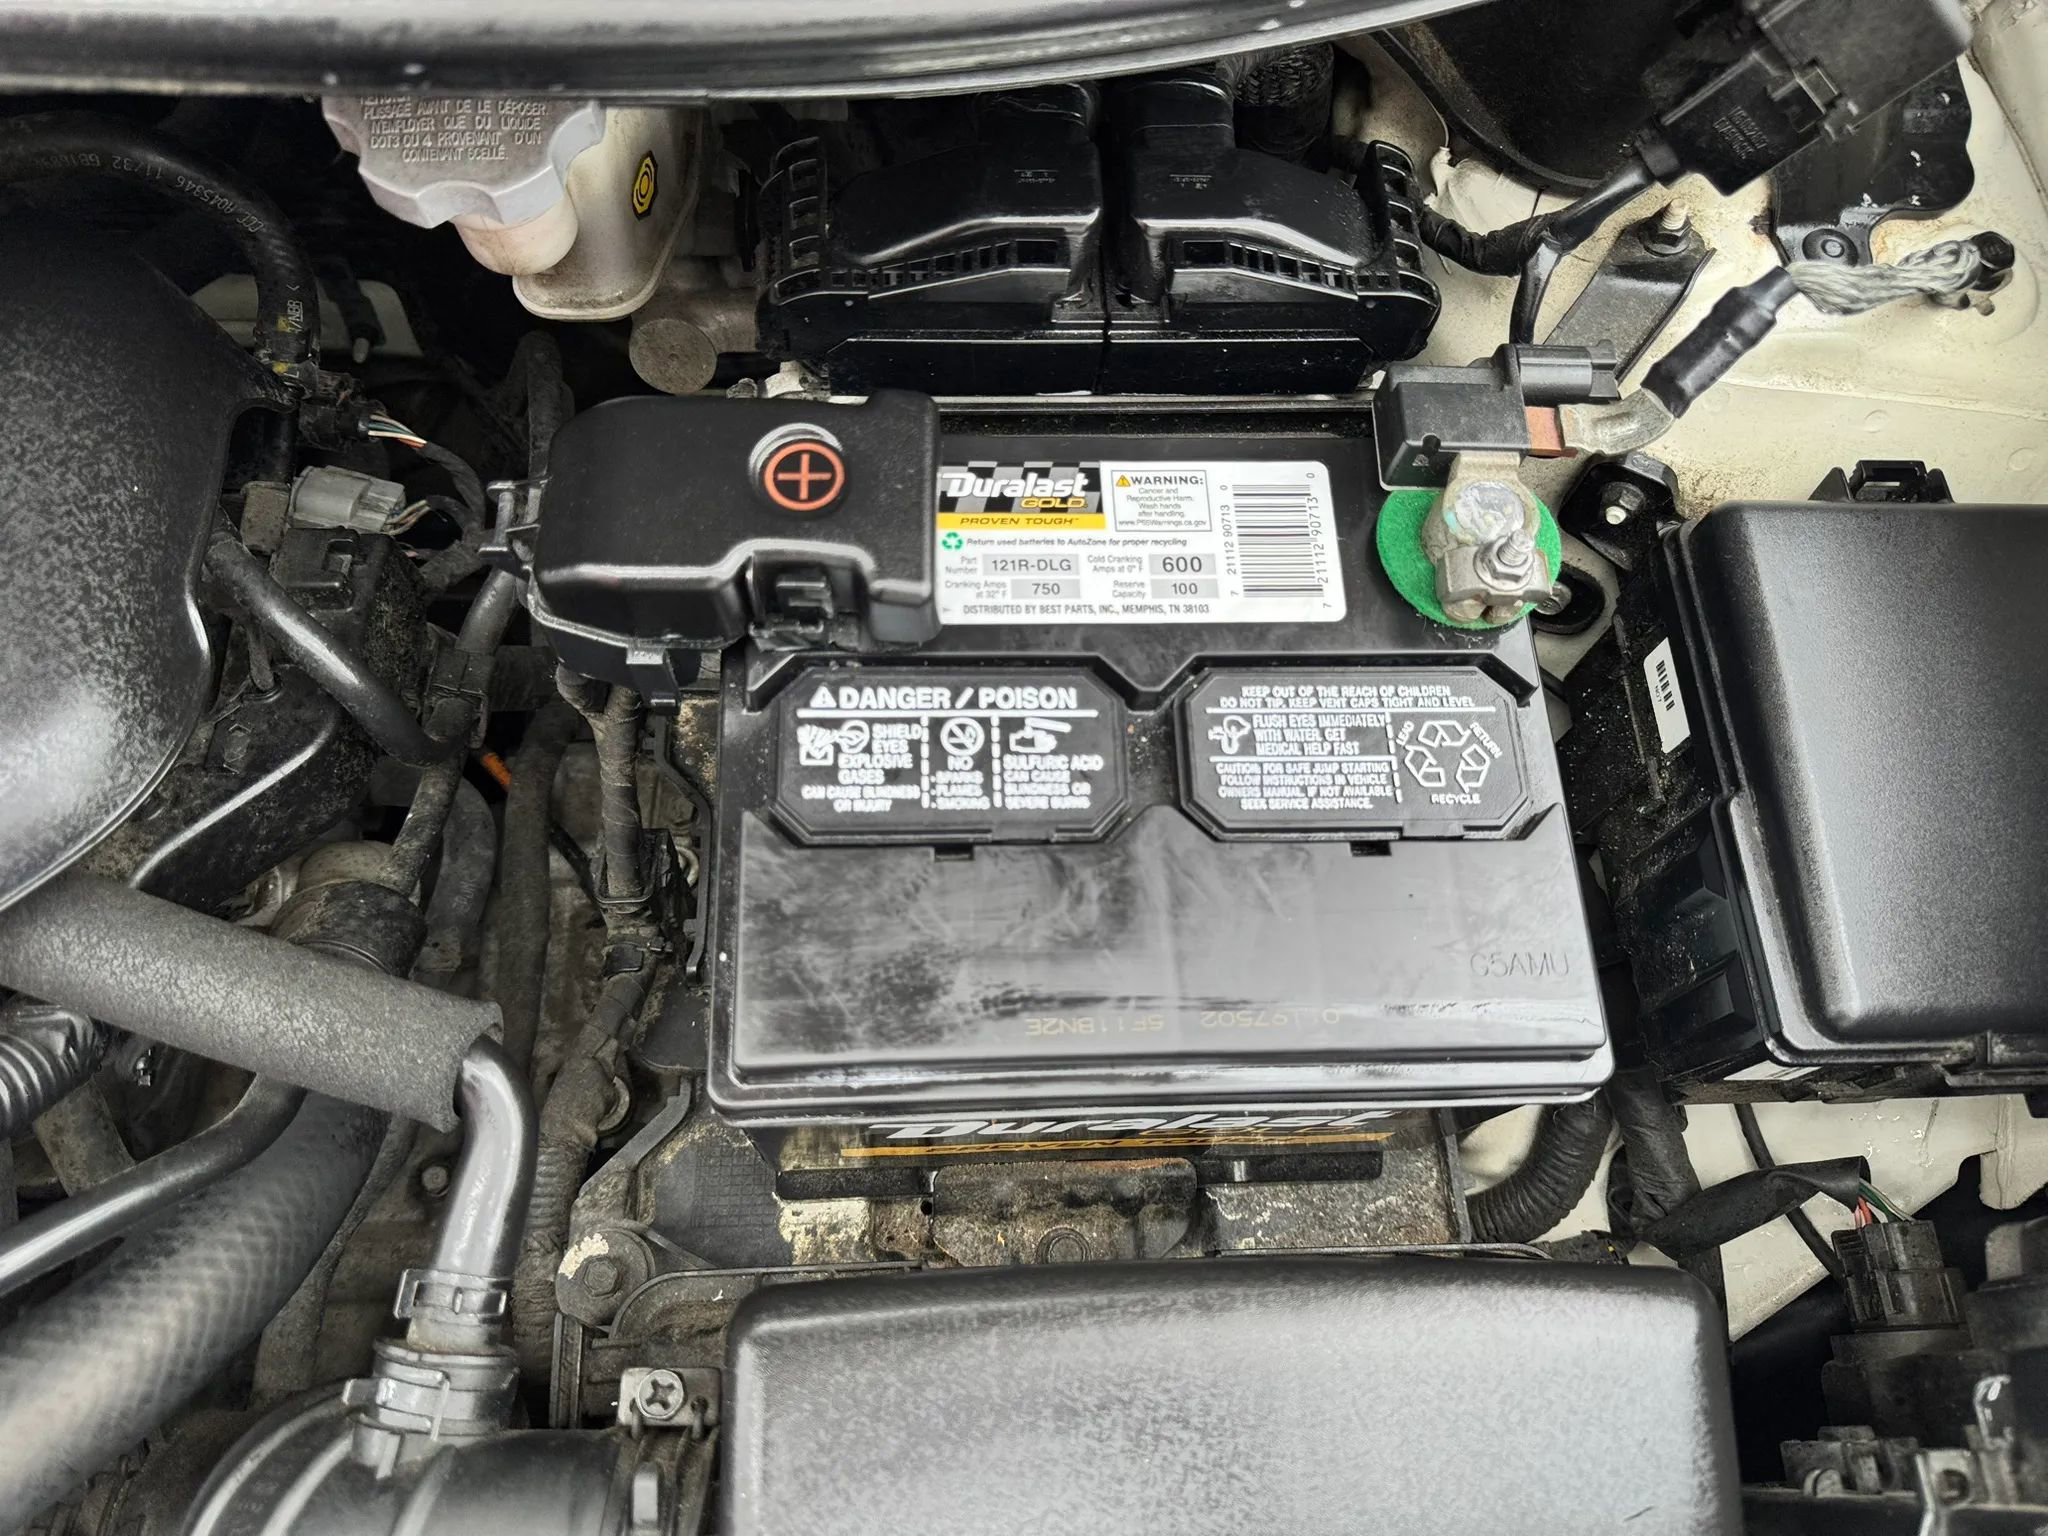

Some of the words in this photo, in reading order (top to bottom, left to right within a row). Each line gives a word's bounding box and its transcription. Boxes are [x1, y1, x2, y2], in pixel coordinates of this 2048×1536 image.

[363, 103, 412, 120] PLISSAGE
[417, 100, 450, 116] AVANT
[456, 99, 472, 115] DE
[478, 99, 492, 115] LE
[444, 115, 467, 131] QUE
[475, 116, 491, 131] DU
[501, 116, 541, 131] LIQUIDE
[403, 134, 419, 149] OU
[421, 133, 433, 148] 4
[438, 131, 502, 147] PROVENANT
[515, 131, 541, 145] D'UN
[402, 148, 464, 163] CONTENANT
[937, 472, 1088, 497] Duralast
[1130, 476, 1204, 485] WARNING:
[1020, 497, 1086, 508] GOLD
[1126, 495, 1171, 503] Reproductive
[959, 517, 1020, 525] PROVEN
[1220, 504, 1233, 537] 90713
[1307, 497, 1321, 537] 90713
[1150, 539, 1188, 547] recycling
[960, 556, 977, 564] Part
[1087, 555, 1106, 563] Cold
[1107, 555, 1143, 565] Cranking
[1162, 557, 1203, 572] 600
[1223, 541, 1236, 575] 21112
[1313, 543, 1328, 584] 21112
[992, 559, 1072, 571] 121R-DLG
[1092, 565, 1116, 573] Amps
[945, 580, 981, 589] Cranking
[983, 580, 1007, 589] Amps
[1032, 583, 1061, 595] 750
[1113, 580, 1145, 588] Reserve
[1171, 583, 1199, 595] 100
[1112, 590, 1146, 599] Capacity
[963, 604, 1022, 614] DISTRIBUTED
[1025, 604, 1037, 614] BY
[1039, 604, 1062, 614] BEST
[1065, 604, 1097, 615] PARTS,
[1121, 604, 1167, 615] MEMPHIS,
[1168, 604, 1180, 613] TN
[1182, 604, 1210, 613] 38103
[838, 686, 952, 710] DANGER
[977, 686, 1078, 710] POISON
[1241, 686, 1271, 698] KEEP
[1272, 686, 1296, 698] OUT
[1298, 686, 1314, 698] OF
[1317, 686, 1341, 697] THE
[1341, 686, 1379, 697] REACH
[1380, 686, 1395, 697] OF
[1397, 685, 1451, 697] CHILDREN
[1220, 697, 1238, 708] DO
[1240, 697, 1263, 708] NOT
[1265, 697, 1286, 708] TIP.
[1288, 697, 1318, 708] KEEP
[1320, 697, 1348, 708] VENT
[1350, 697, 1381, 708] CAPS
[1382, 697, 1414, 708] TIGHT
[1417, 697, 1441, 708] AND
[1442, 696, 1475, 708] LEVEL
[1252, 714, 1288, 729] FLUSH
[1289, 714, 1317, 728] EYES
[1318, 714, 1386, 728] IMMEDIATELY
[871, 723, 923, 740] SHIELD
[1253, 728, 1283, 742] WITH
[1325, 728, 1347, 741] GET
[1395, 720, 1415, 746] LEAD
[1470, 721, 1503, 759] RETURN
[871, 740, 909, 754] EYES
[1255, 741, 1302, 756] MEDICAL
[1303, 741, 1332, 755] HELP
[1333, 741, 1361, 755] FAST
[837, 753, 914, 769] EXPLOSIVE
[946, 754, 974, 771] NO
[1002, 754, 1069, 770] SULFURIC
[1070, 754, 1104, 770] ACID
[1262, 762, 1285, 773] FOR
[1285, 762, 1312, 773] SAFE
[1312, 762, 1340, 773] JUMP
[1341, 762, 1391, 773] STARTING
[837, 769, 885, 785] GASES
[1003, 771, 1029, 783] CAN
[1219, 774, 1262, 786] FOLLOW
[1262, 774, 1333, 786] INSTRUCTIONS
[1334, 774, 1347, 785] IN
[1348, 774, 1388, 785] VEHICLE
[1307, 786, 1318, 797] IF
[1319, 786, 1342, 797] NOT
[1342, 786, 1394, 797] AVAILABLE
[1240, 798, 1269, 810] SEEK
[1269, 798, 1309, 809] SERVICE
[1430, 793, 1481, 804] RECYCLE
[868, 1110, 1394, 1139] Duralast
